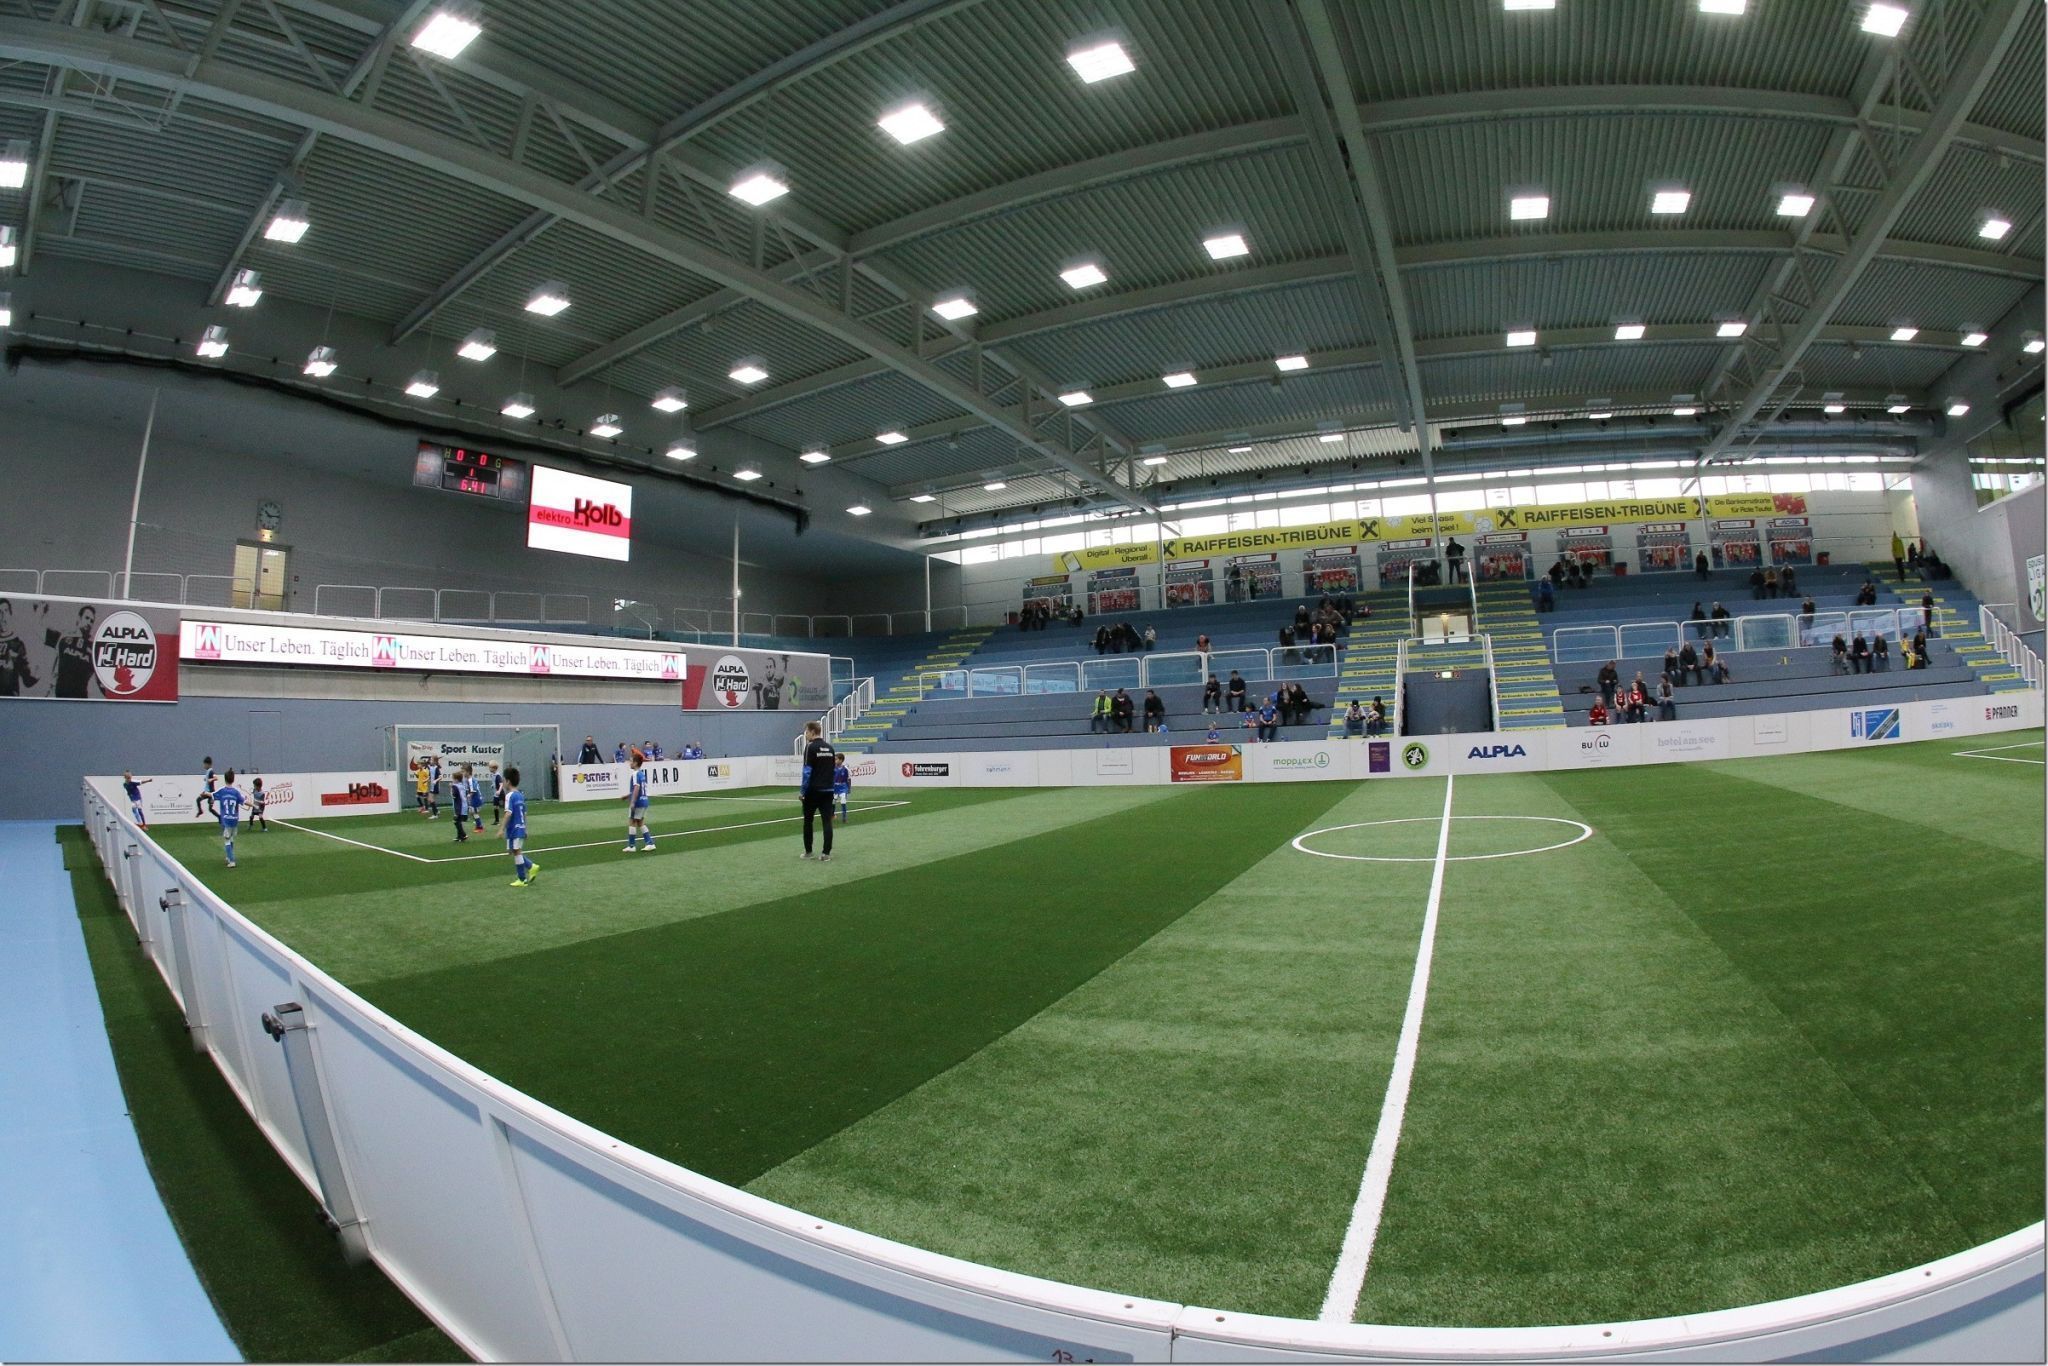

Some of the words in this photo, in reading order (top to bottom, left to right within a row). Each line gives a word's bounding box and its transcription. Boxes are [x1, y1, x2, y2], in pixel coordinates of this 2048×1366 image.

[537, 510, 571, 525] elektro
[1524, 500, 1687, 523] RAIFFEISEN-TRIBÜNE
[1411, 516, 1426, 524] Viel
[1183, 525, 1352, 554] RAIFFEISEN-TRIBÜNE
[1087, 550, 1109, 559] Digital
[1115, 546, 1147, 555] Regional
[1122, 554, 1148, 563] Überall
[102, 626, 149, 639] ALPLA
[117, 649, 153, 667] Hard
[225, 634, 265, 653] Unser
[270, 637, 315, 655] Leben.
[320, 640, 369, 660] Täglich
[399, 645, 435, 662] Unser
[440, 648, 480, 663] Leben.
[484, 650, 527, 666] Täglich
[552, 653, 583, 667] Unser
[587, 655, 621, 670] Leben.
[625, 658, 660, 674] Täglich
[718, 665, 745, 674] ALPLA
[727, 679, 747, 690] Hard
[1992, 706, 2018, 720] PFANNER
[441, 744, 467, 754] Sport
[472, 746, 502, 754] Kuster
[1468, 744, 1526, 759] ALPLA
[223, 799, 237, 815] 17
